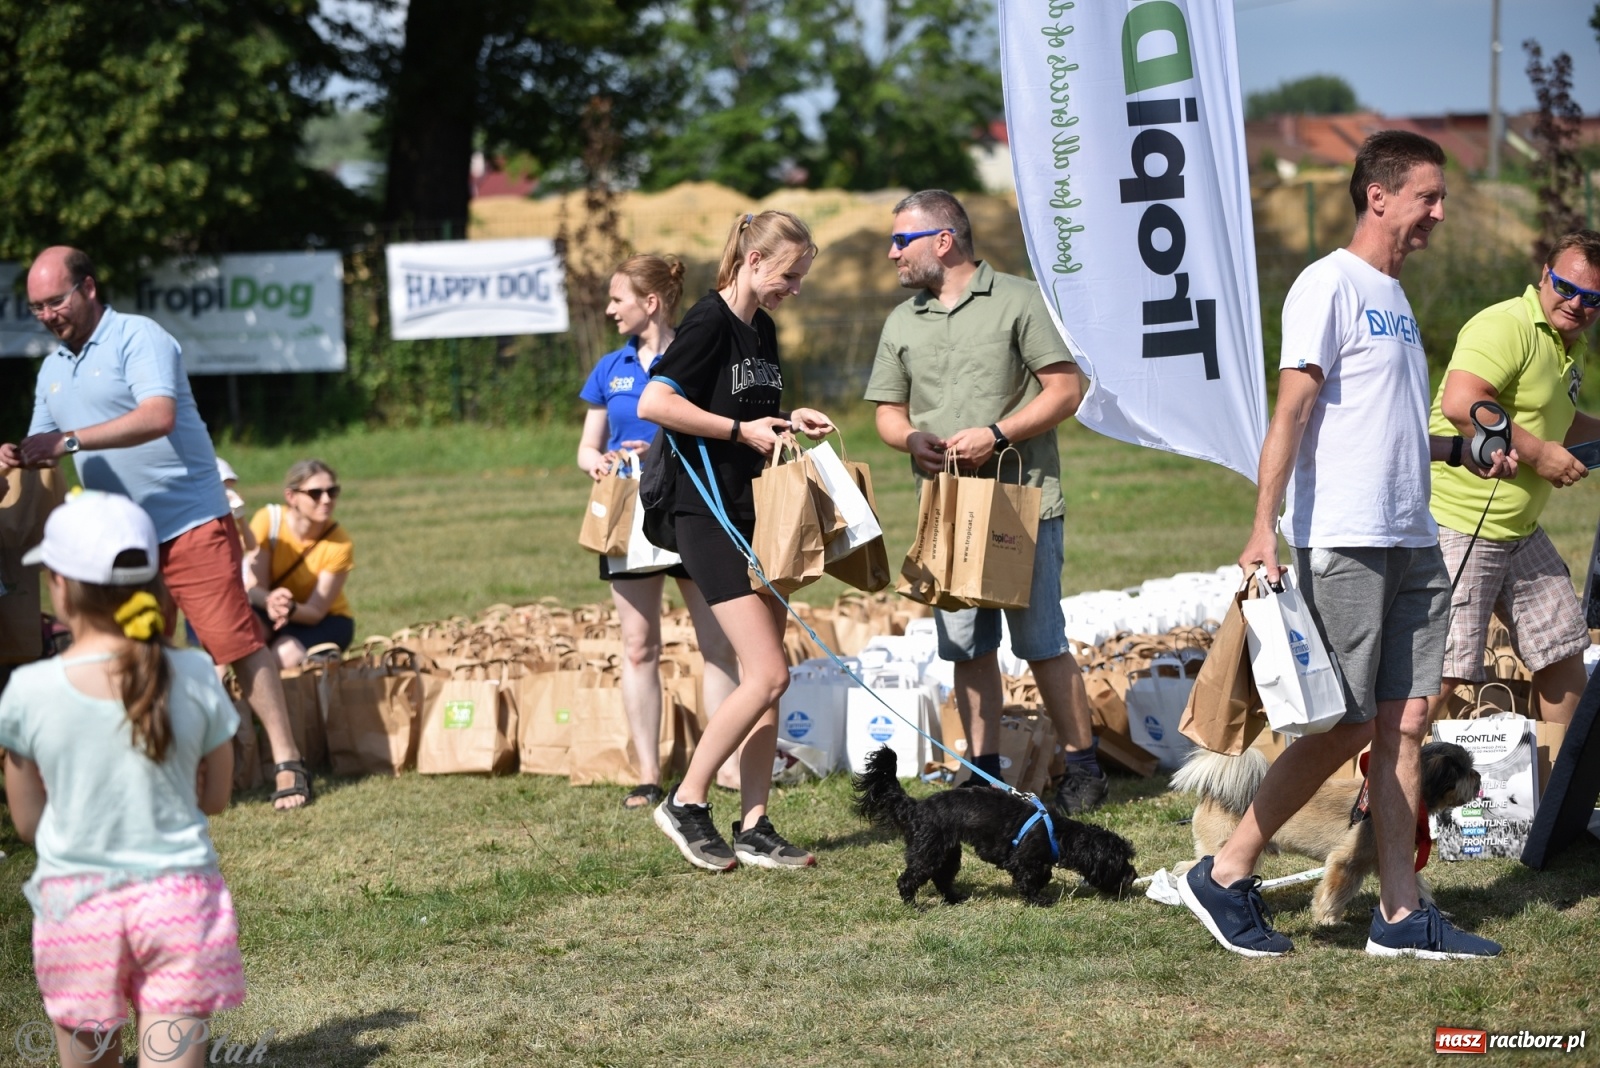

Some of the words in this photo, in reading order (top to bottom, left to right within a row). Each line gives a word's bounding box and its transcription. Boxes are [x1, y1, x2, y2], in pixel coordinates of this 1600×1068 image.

[131, 270, 314, 319] TropiDog
[405, 274, 490, 309] HAPPY
[498, 268, 551, 301] DOG
[932, 508, 941, 560] www.tropicat.pl
[963, 511, 974, 563] www.tropicat.pl
[991, 530, 1016, 545] TropiCat
[1455, 733, 1507, 743] FRONTLINE
[1462, 819, 1508, 828] FRONTLINE
[1463, 838, 1508, 847] FRONTLINE
[1464, 846, 1481, 854] SPRAY
